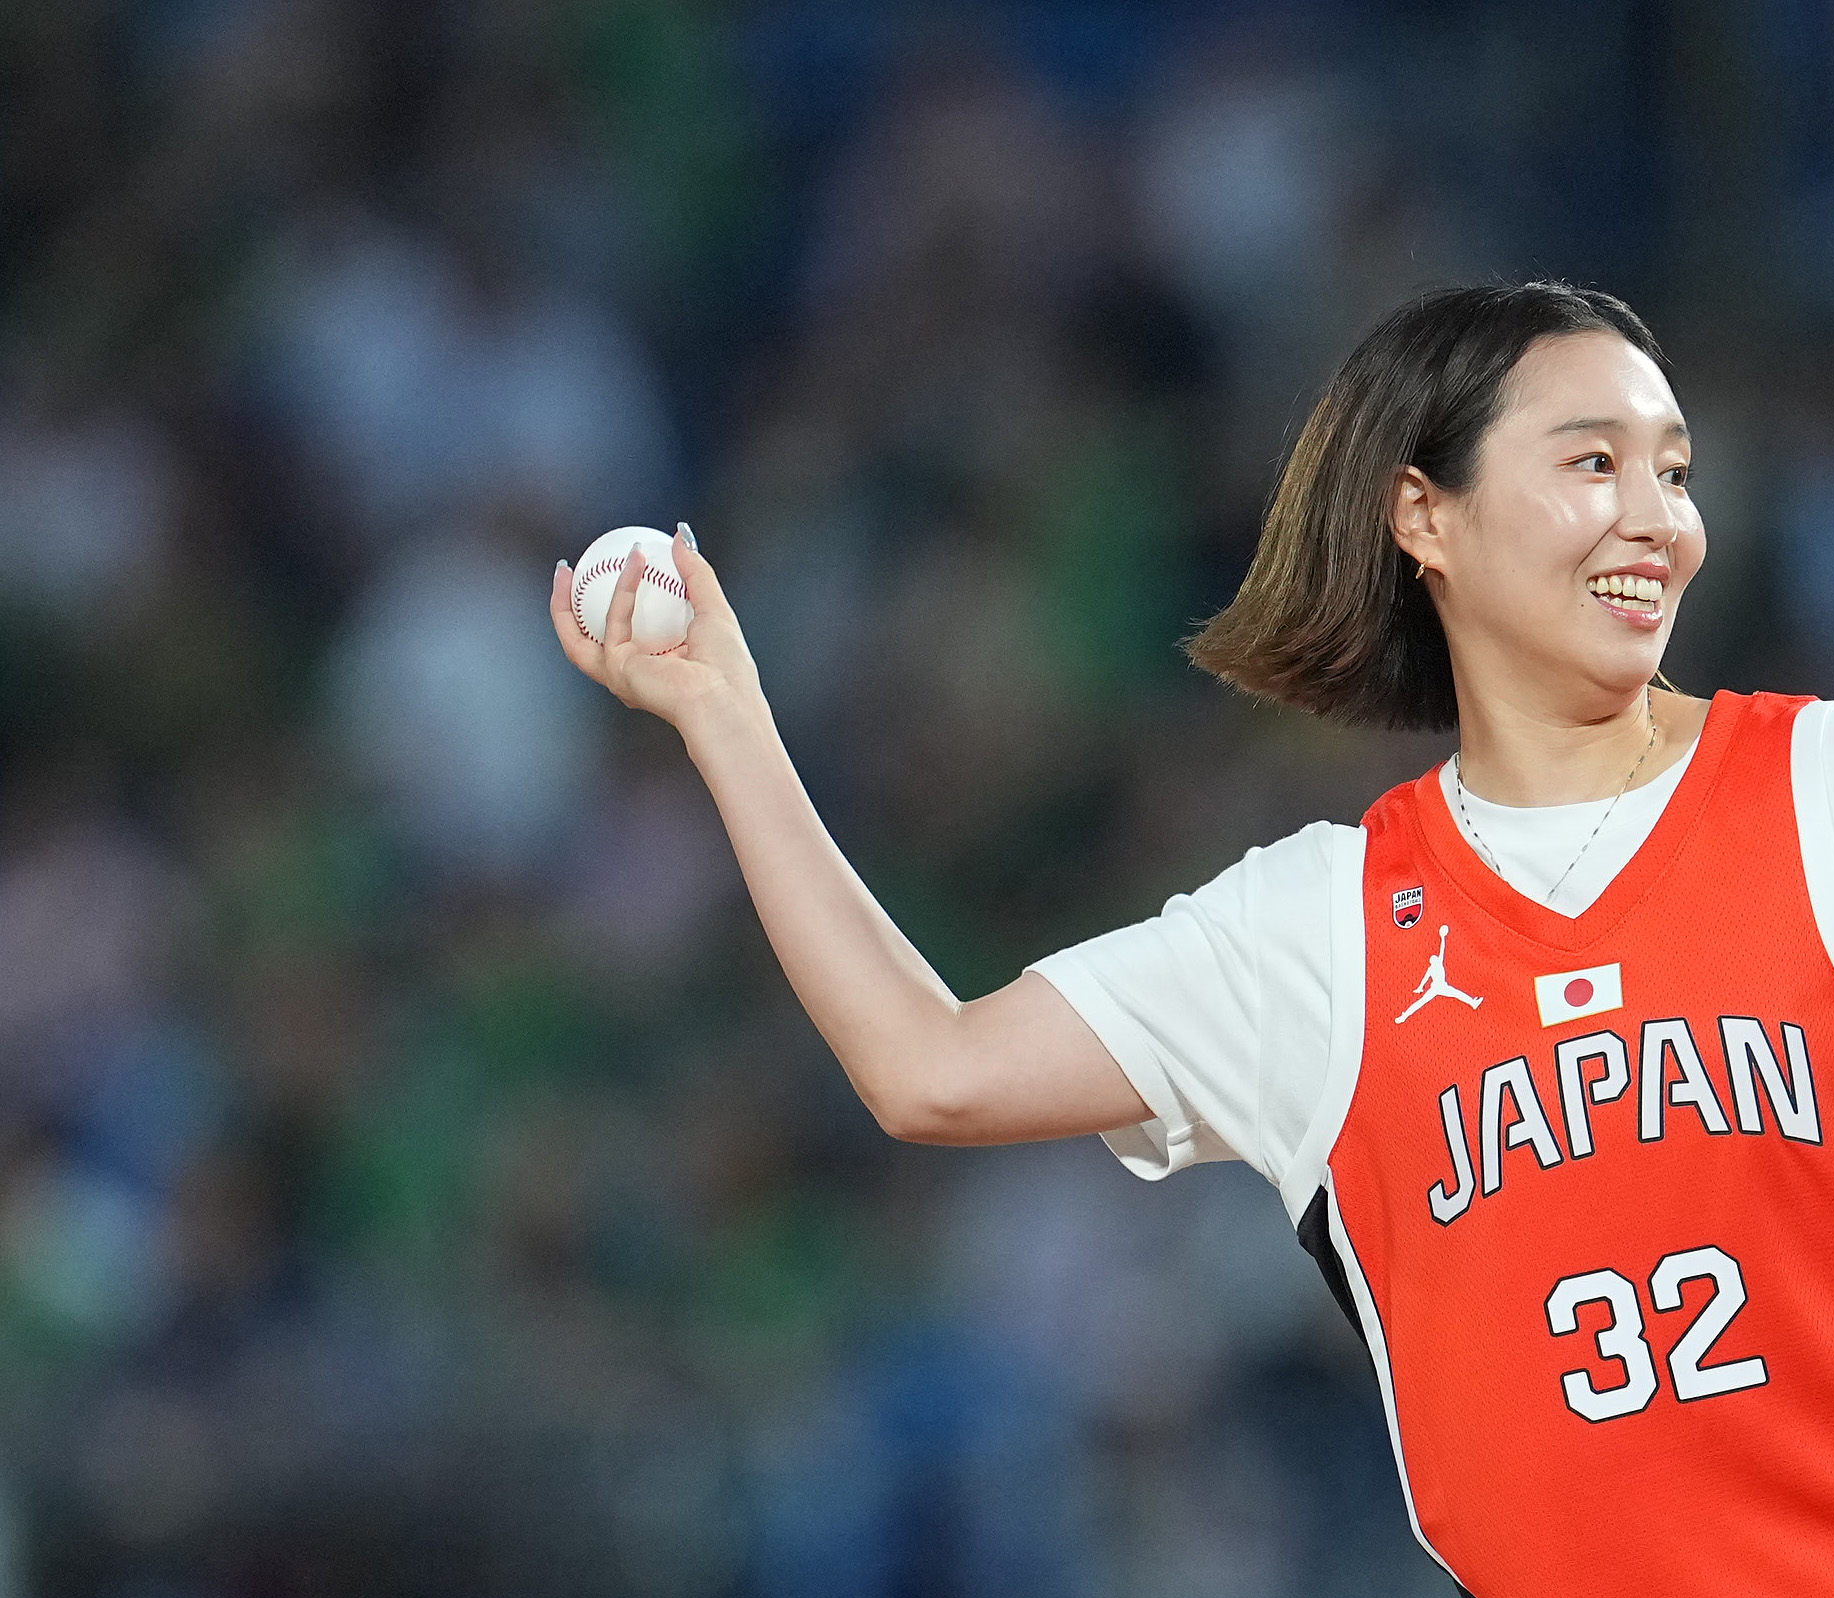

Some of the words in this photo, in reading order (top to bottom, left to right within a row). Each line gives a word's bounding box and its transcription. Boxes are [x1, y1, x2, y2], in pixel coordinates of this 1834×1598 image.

[1395, 888, 1422, 904] JAPAN
[1427, 1015, 1824, 1227] JAPAN
[1543, 1244, 1770, 1424] 32
